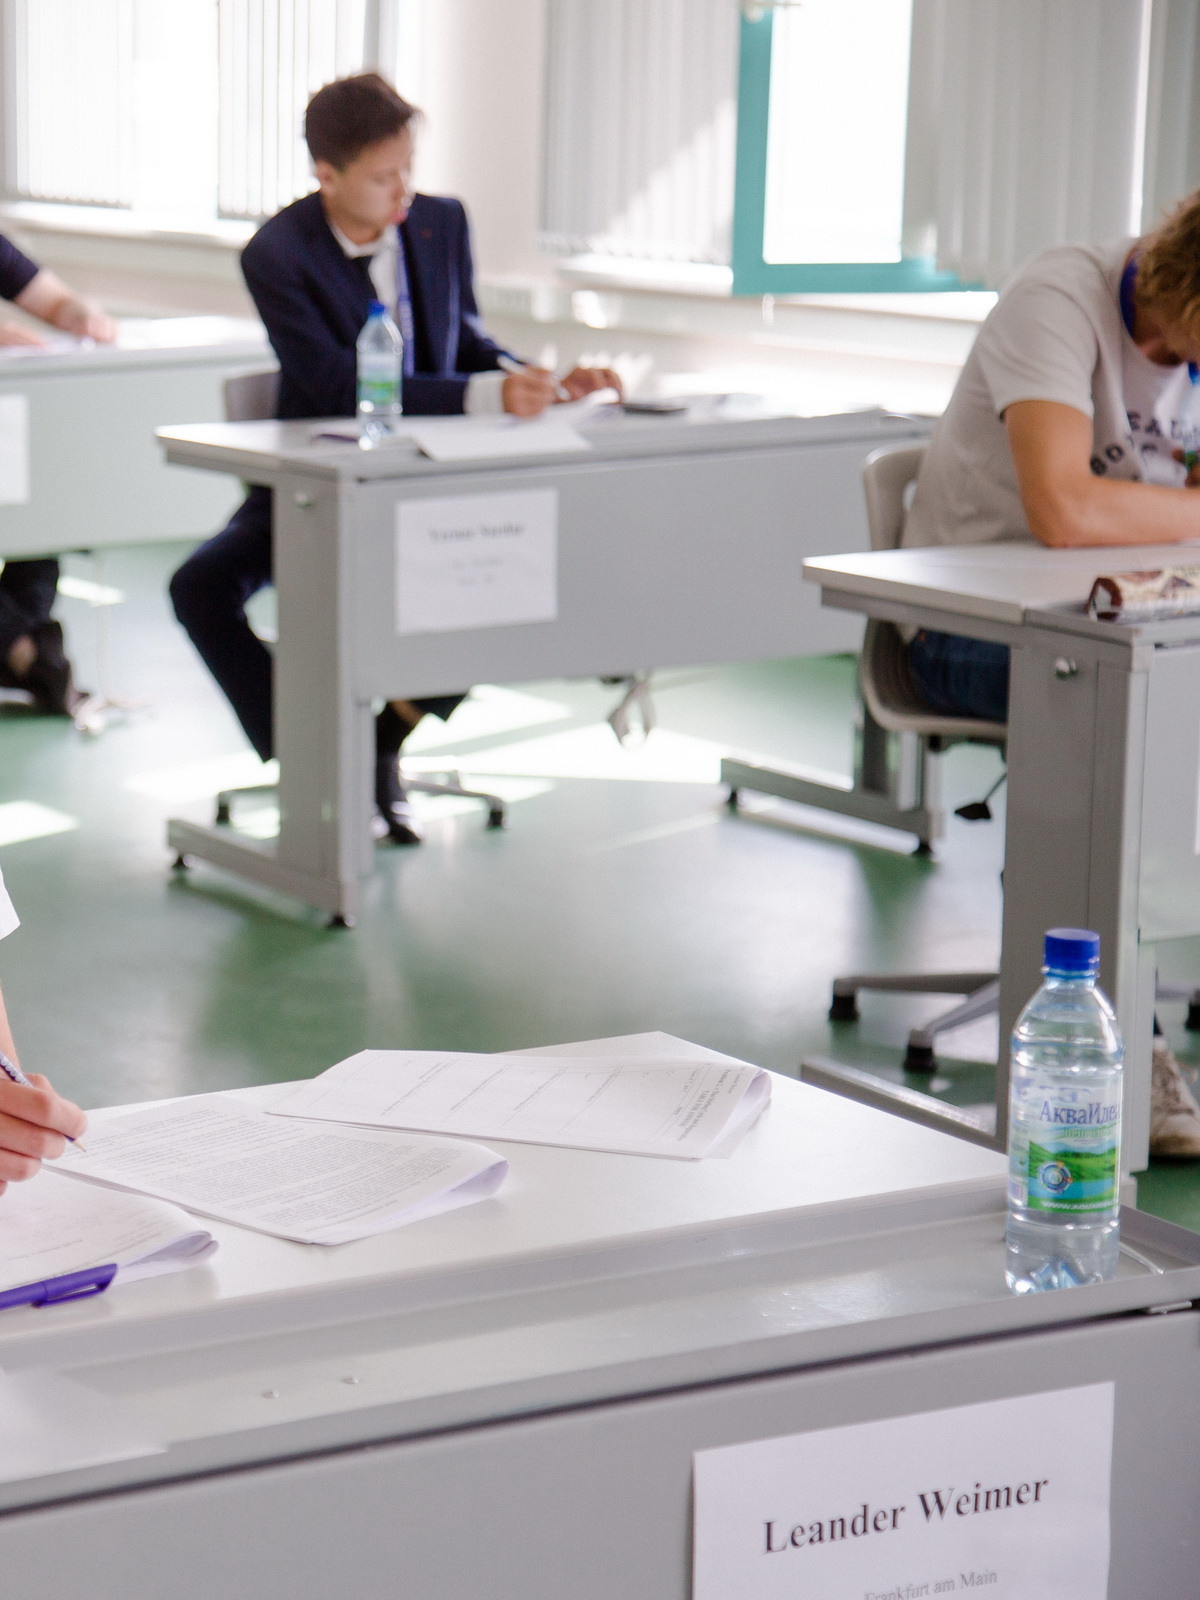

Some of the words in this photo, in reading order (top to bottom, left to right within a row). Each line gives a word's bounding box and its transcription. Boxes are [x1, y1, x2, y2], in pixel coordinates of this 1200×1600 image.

[763, 1504, 906, 1554] Leander
[917, 1479, 1049, 1523] Weimer
[934, 1578, 956, 1594] am
[960, 1570, 998, 1589] Main
